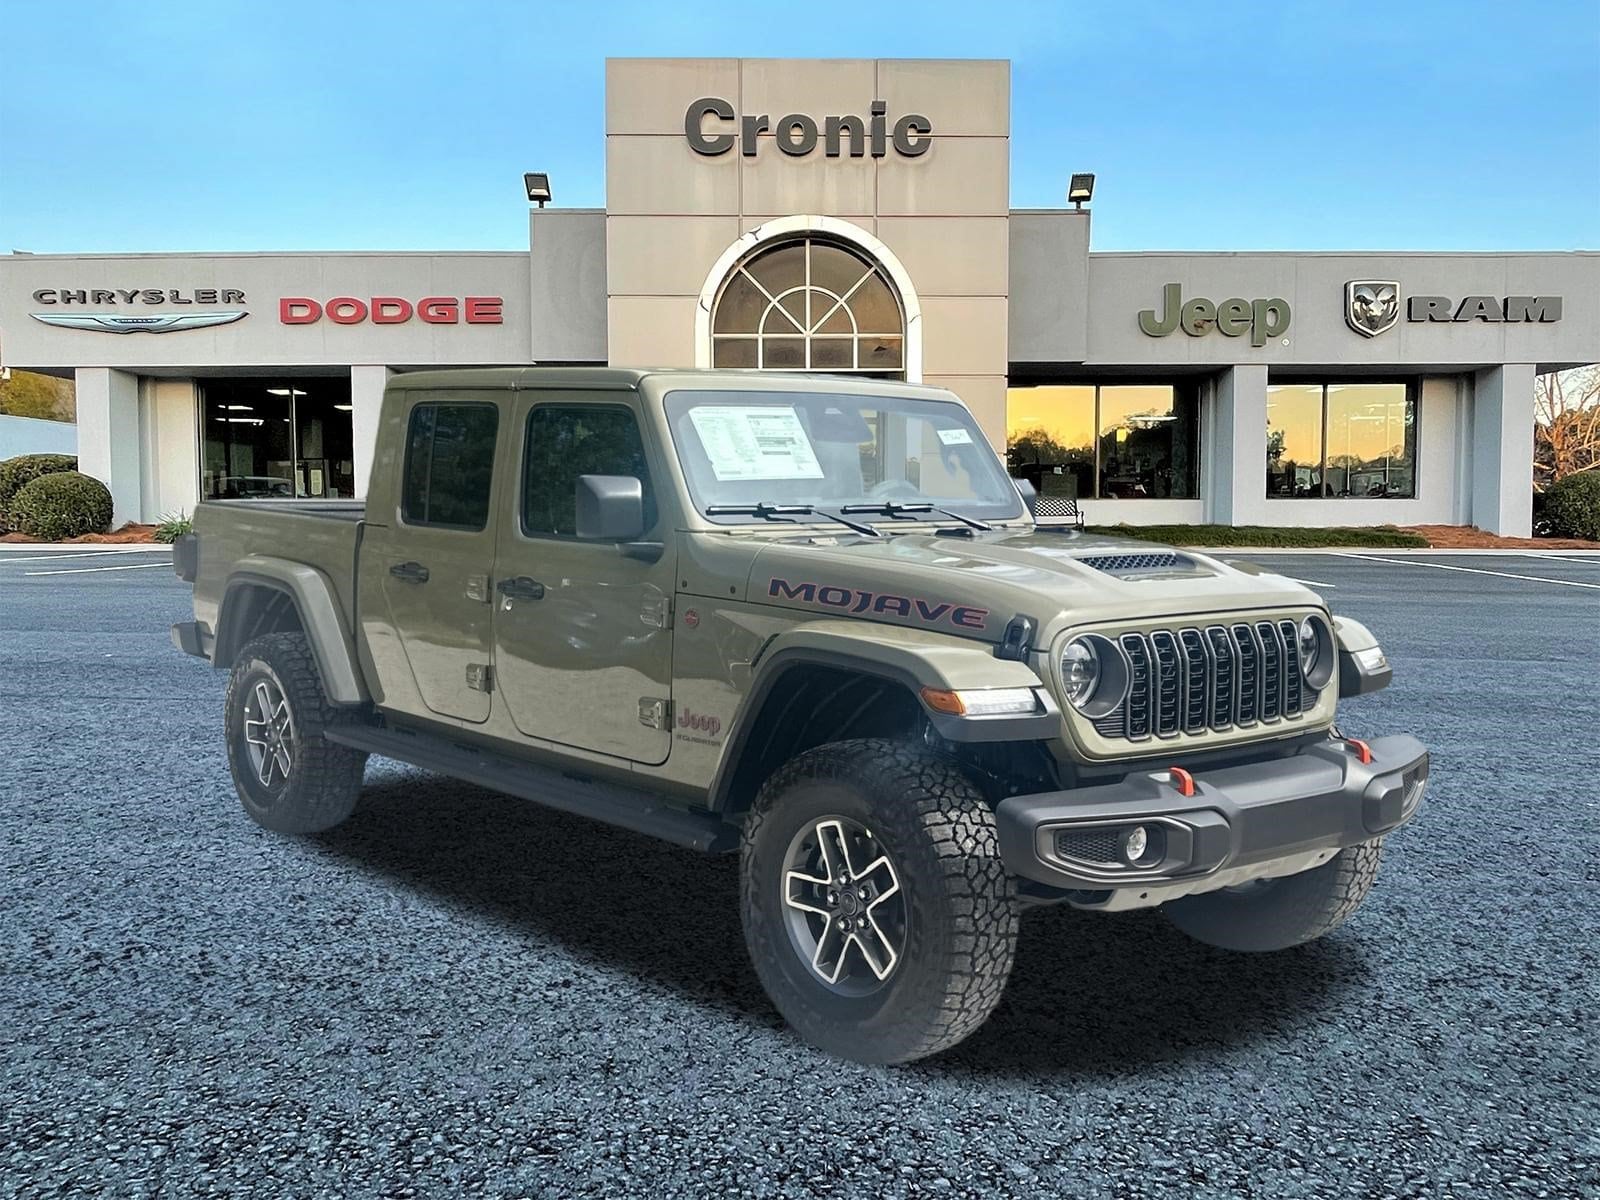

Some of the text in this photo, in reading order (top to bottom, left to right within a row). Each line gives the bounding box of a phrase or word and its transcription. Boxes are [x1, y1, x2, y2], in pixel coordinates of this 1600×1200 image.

[684, 97, 933, 157] Cronic
[33, 289, 246, 304] CHRYSLER
[279, 297, 503, 324] DODGE
[1138, 283, 1291, 347] Jeep
[1407, 296, 1563, 322] RAM
[769, 577, 989, 629] MOJAVE
